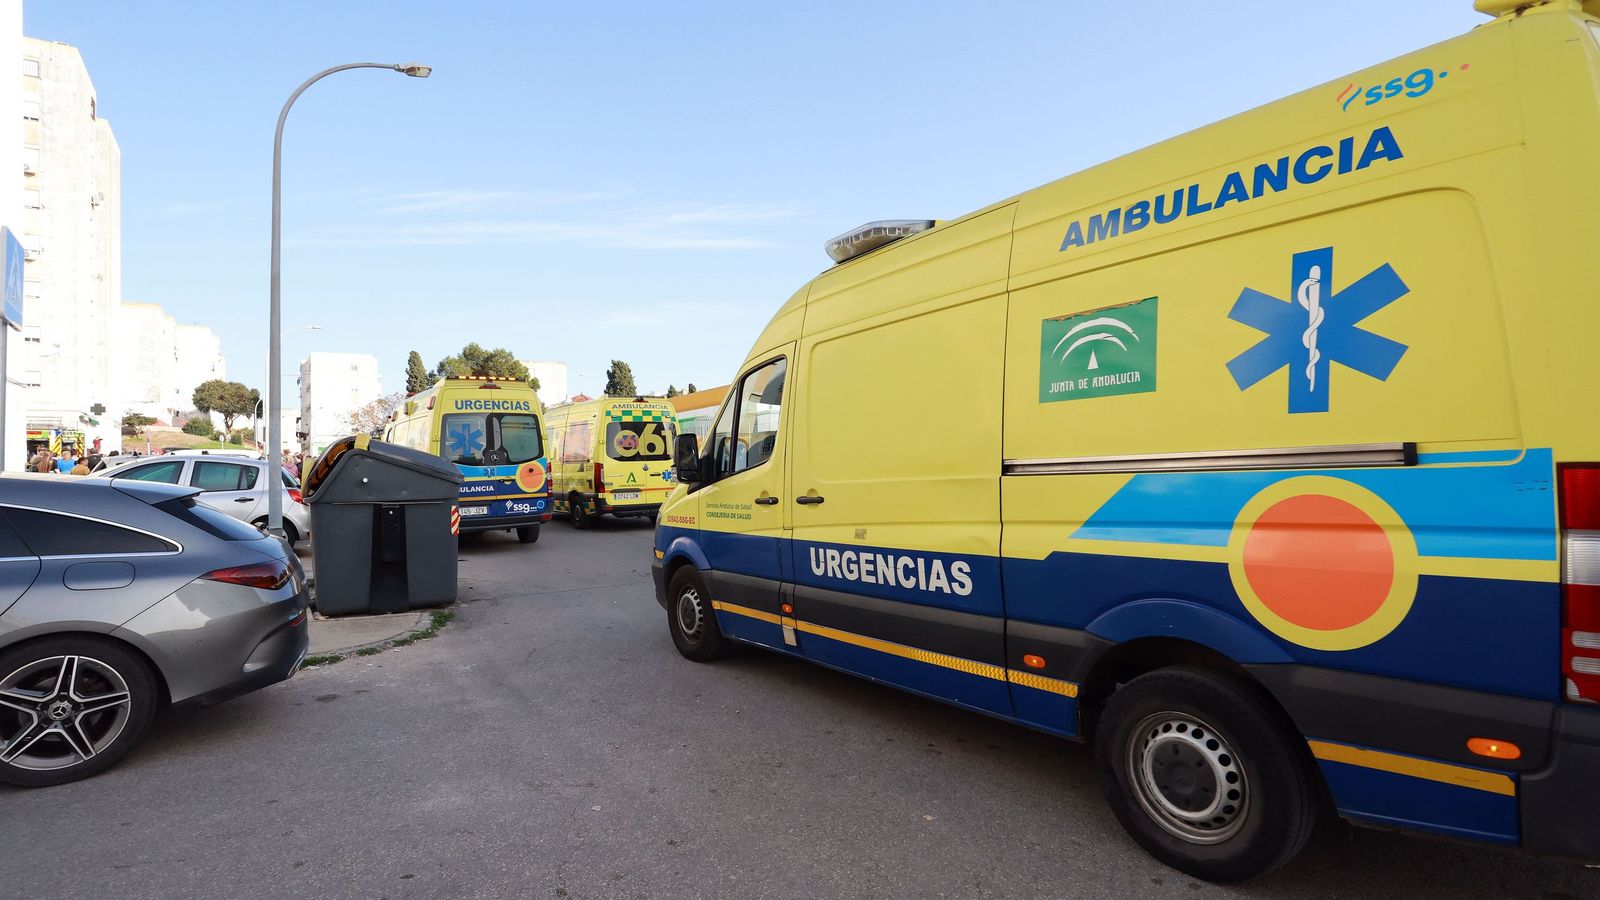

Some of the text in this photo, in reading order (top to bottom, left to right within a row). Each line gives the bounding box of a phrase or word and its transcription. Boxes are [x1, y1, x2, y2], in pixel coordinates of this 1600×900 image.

[1059, 126, 1404, 252] AMBULANCIA
[1049, 371, 1141, 393] JUNTA DE ANDALUCIA
[455, 399, 530, 411] URGENCIAS
[459, 485, 494, 493] ULANCIA
[809, 546, 973, 597] URGENCIAS
